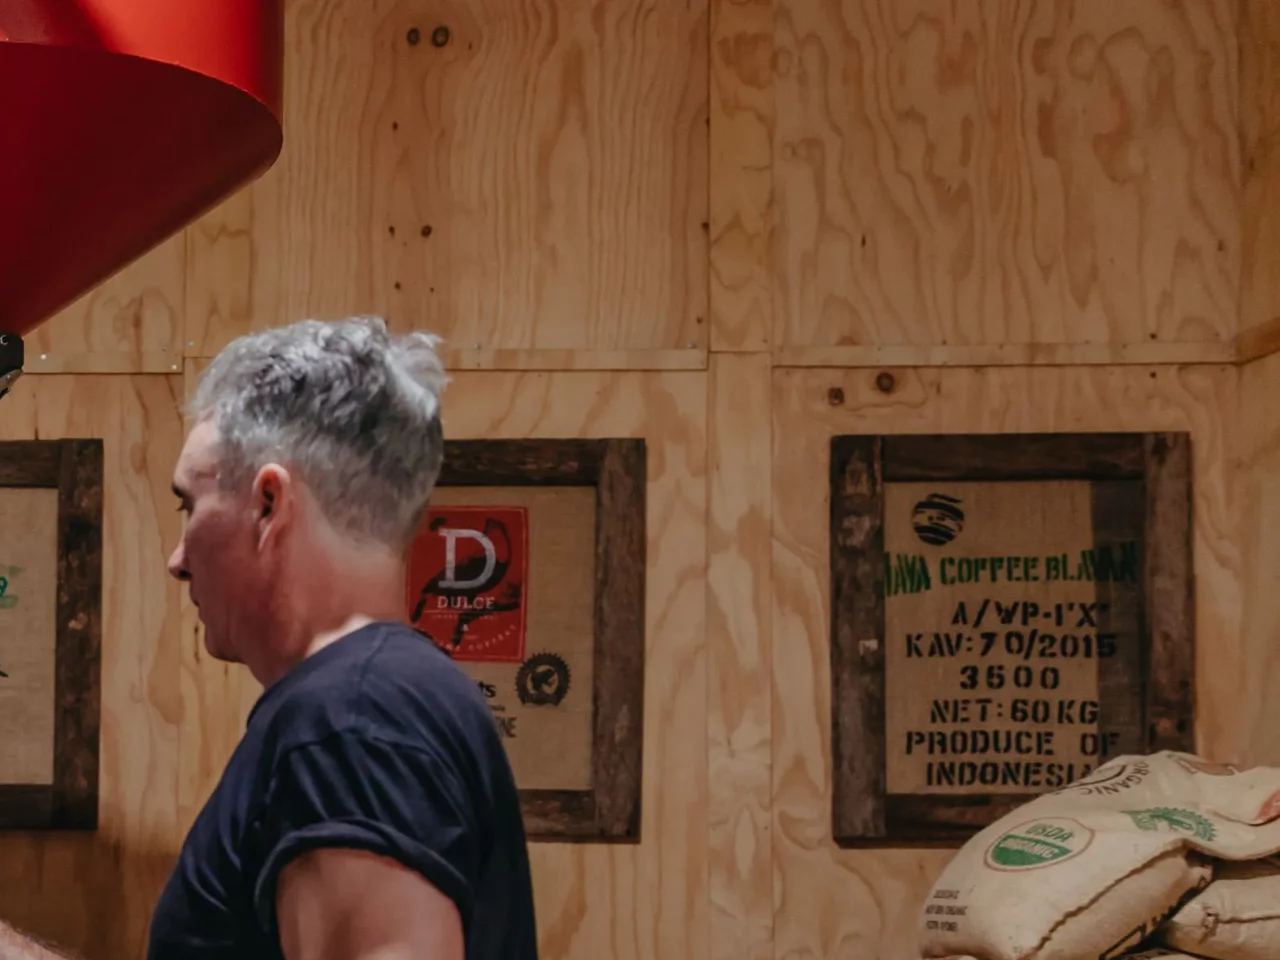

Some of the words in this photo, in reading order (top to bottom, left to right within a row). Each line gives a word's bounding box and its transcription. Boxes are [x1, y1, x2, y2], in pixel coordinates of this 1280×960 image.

[438, 528, 497, 589] D
[939, 556, 1039, 585] COFFEE
[437, 596, 496, 609] DULCE
[906, 731, 1055, 755] PRODUCE
[1080, 732, 1119, 755] OF
[1026, 823, 1074, 842] USDA
